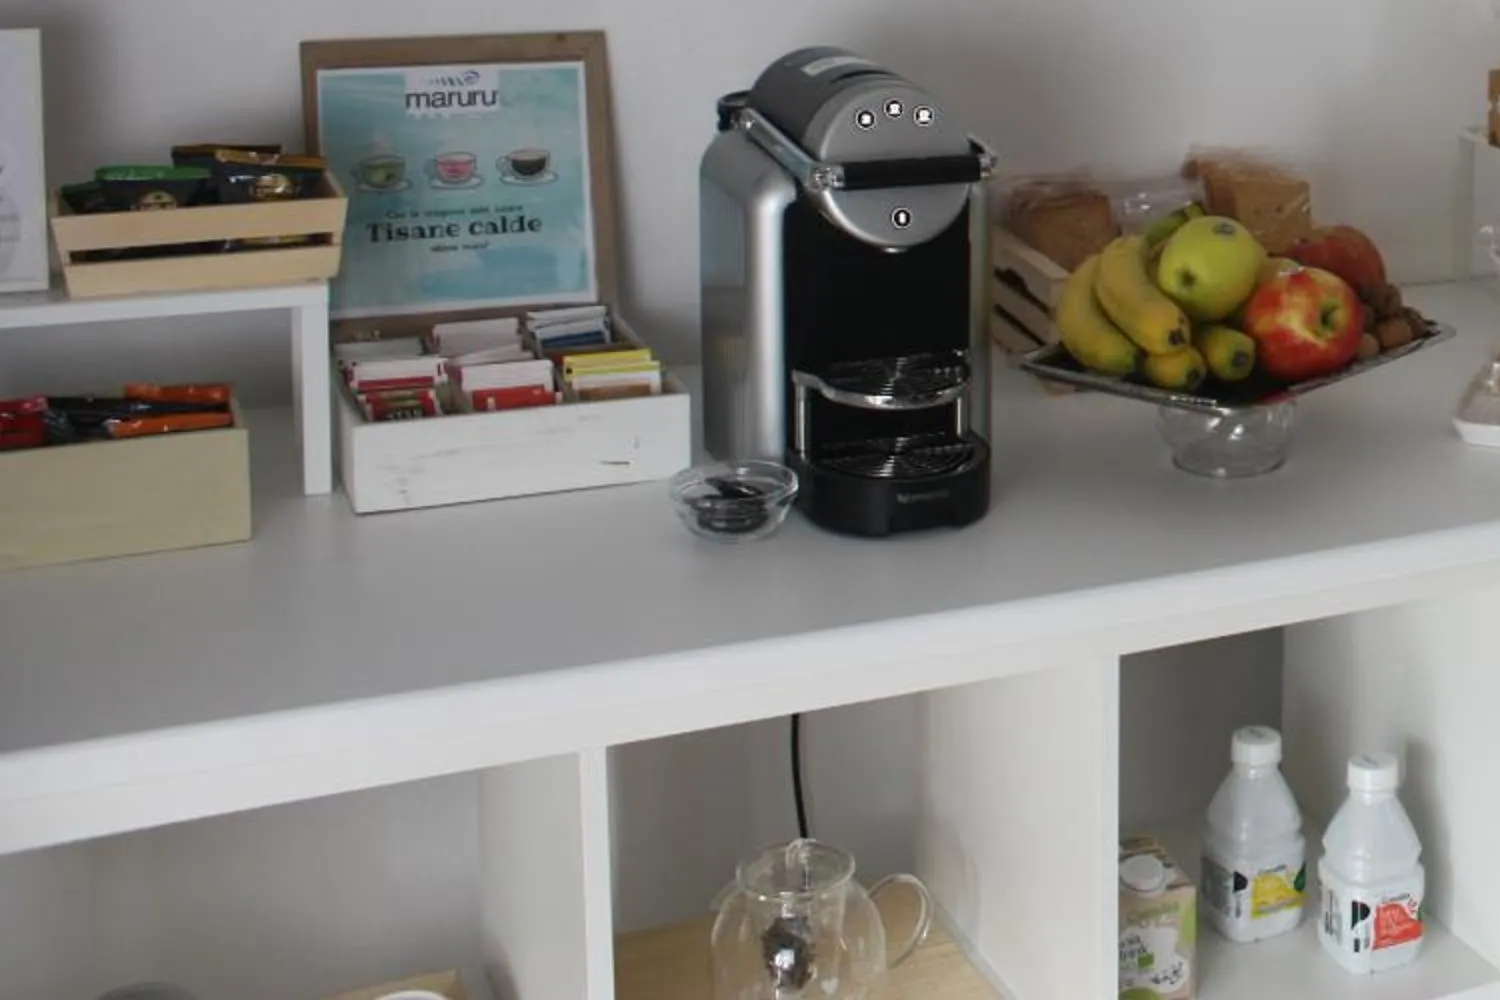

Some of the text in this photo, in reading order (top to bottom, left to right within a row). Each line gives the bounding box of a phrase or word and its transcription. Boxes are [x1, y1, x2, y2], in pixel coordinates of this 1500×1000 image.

[405, 90, 499, 109] maruru
[366, 215, 543, 243] Tisane calde
